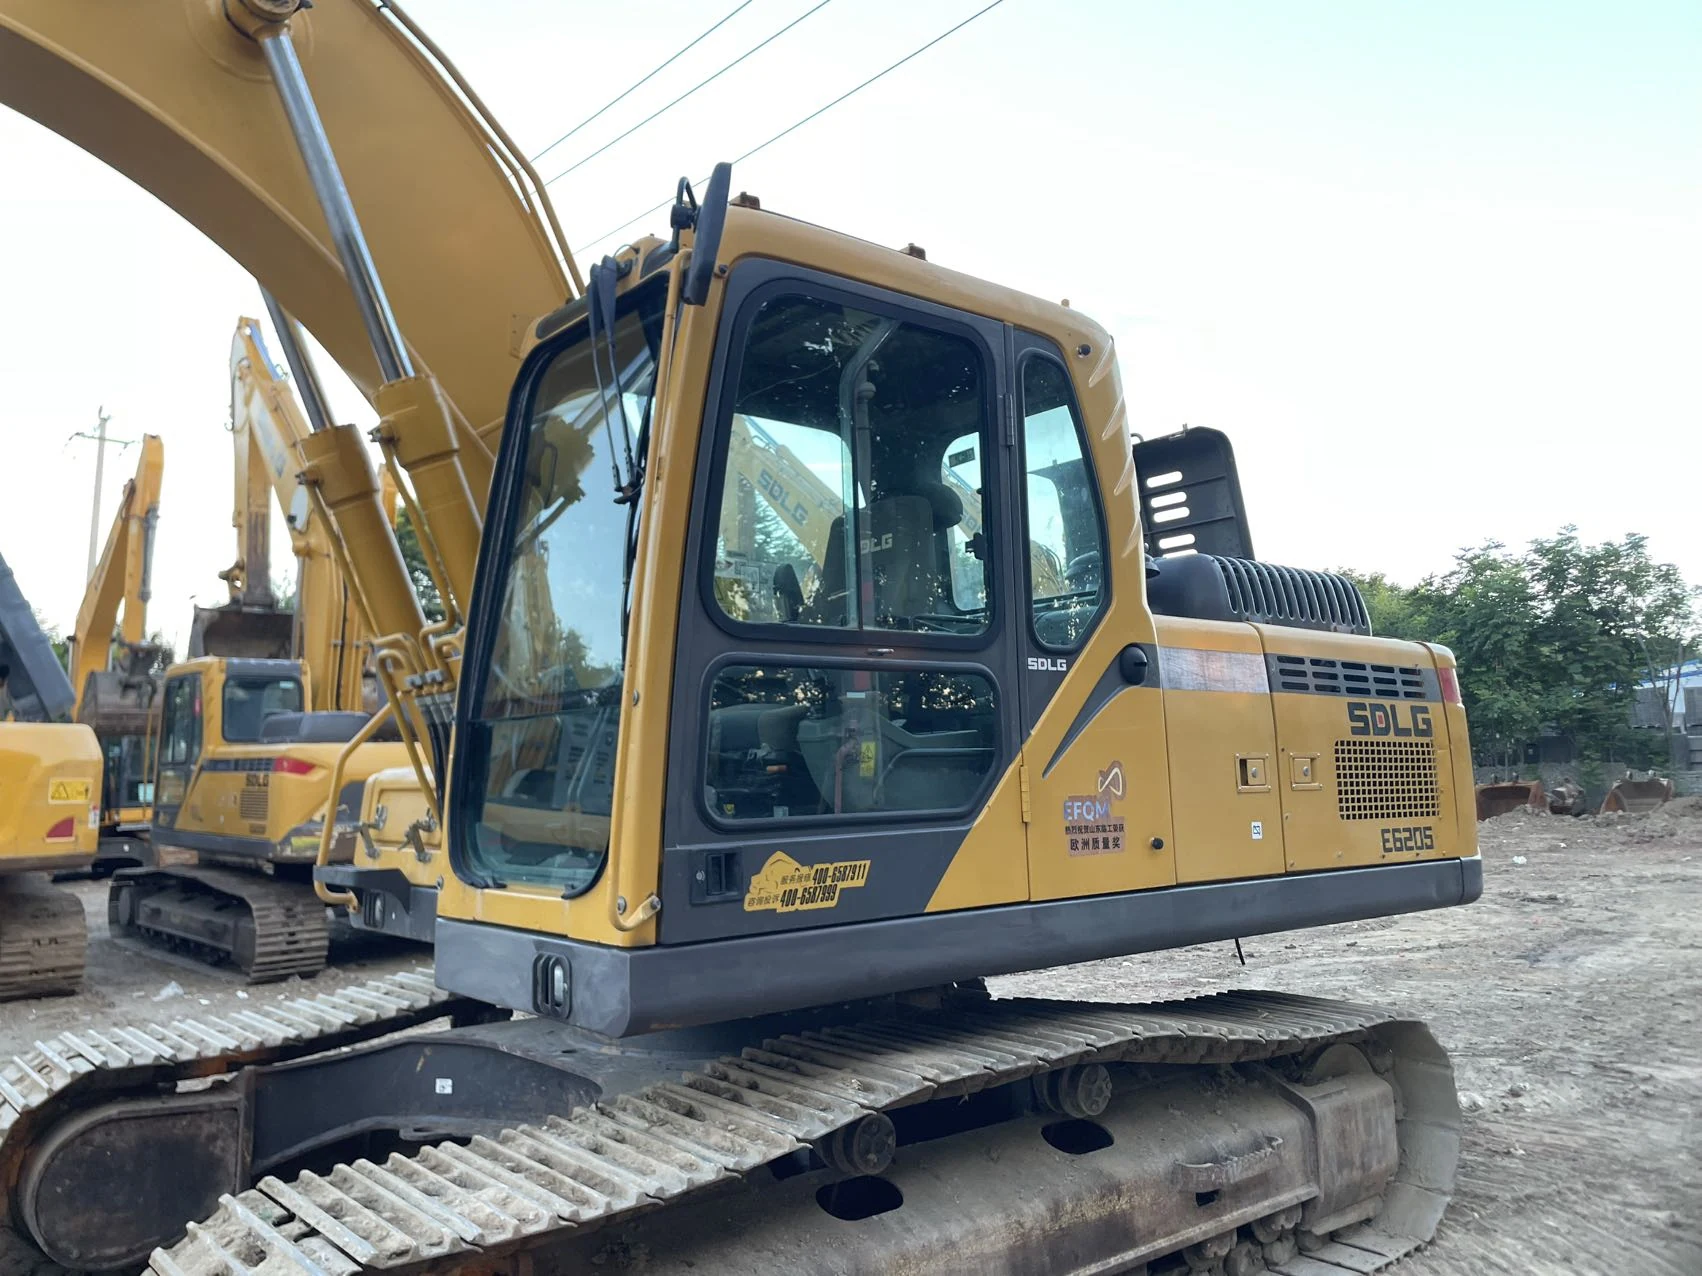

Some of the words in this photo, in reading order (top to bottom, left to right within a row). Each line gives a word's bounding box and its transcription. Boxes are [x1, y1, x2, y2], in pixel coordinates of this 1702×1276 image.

[757, 468, 809, 527] SDLG
[860, 533, 893, 554] DLG
[1027, 657, 1067, 671] SDLG
[1347, 701, 1433, 737] SDLG
[1064, 800, 1110, 821] EFQM
[1070, 836, 1121, 851] 欧洲质量奖
[812, 863, 867, 885] 400-6587911
[780, 884, 838, 908] 400-6587999
